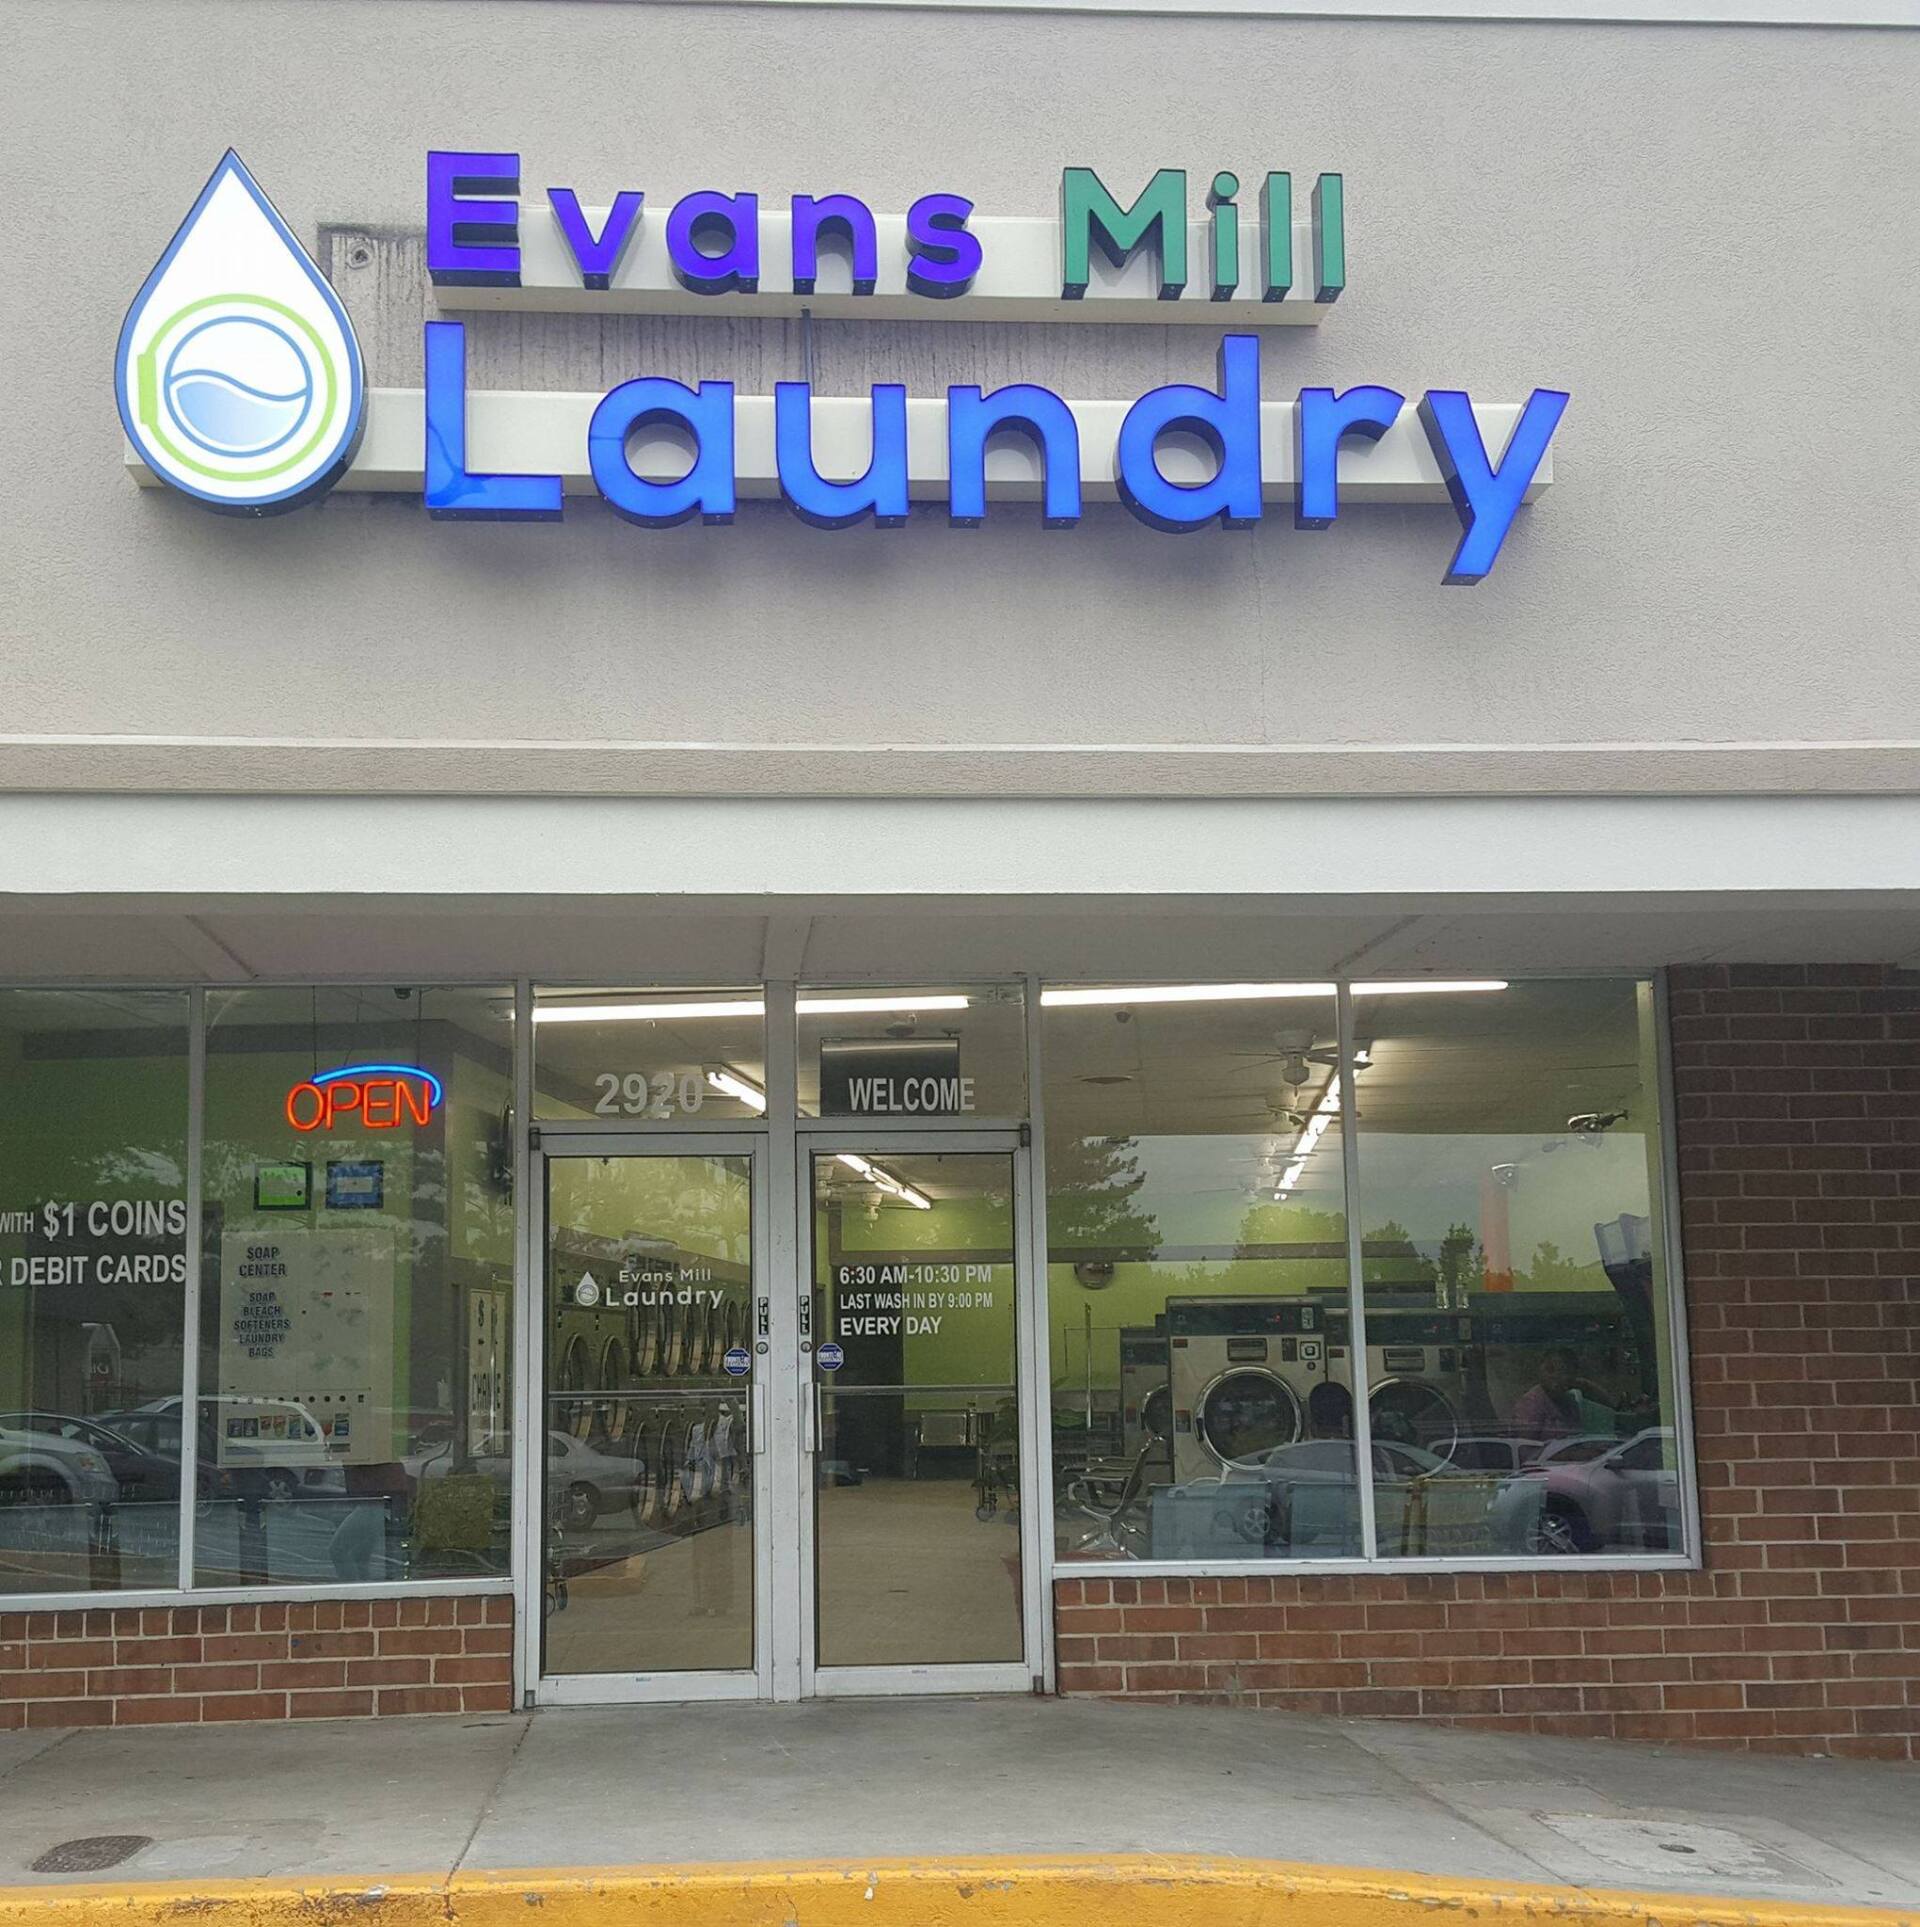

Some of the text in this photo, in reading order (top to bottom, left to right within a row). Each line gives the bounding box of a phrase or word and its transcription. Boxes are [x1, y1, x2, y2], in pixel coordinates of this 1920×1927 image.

[427, 152, 1345, 301] Evans Mill
[425, 321, 1570, 585] Laundry
[595, 1072, 702, 1115] 2920
[848, 1077, 976, 1112] WELCOME
[286, 1080, 431, 1132] OPEN
[43, 1200, 74, 1241] $1
[87, 1200, 187, 1237] COINS
[247, 1247, 280, 1260] SOAP
[11, 1256, 89, 1286] DEBIT
[96, 1254, 187, 1284] CARDS
[239, 1263, 288, 1277] CENTER
[619, 1268, 711, 1283] Evans Mill
[839, 1265, 992, 1284] 6:30 AM-10:30 PM
[606, 1286, 724, 1309] Laundry
[840, 1292, 992, 1310] LAST WASH IN BY 9:00 PM
[243, 1306, 281, 1316] BLEACH
[801, 1296, 809, 1334] PULL
[234, 1320, 291, 1330] SOFTENERS
[840, 1316, 942, 1336] EVERY DAY
[239, 1333, 285, 1344] LAUNDRY
[248, 1347, 274, 1358] BAGS
